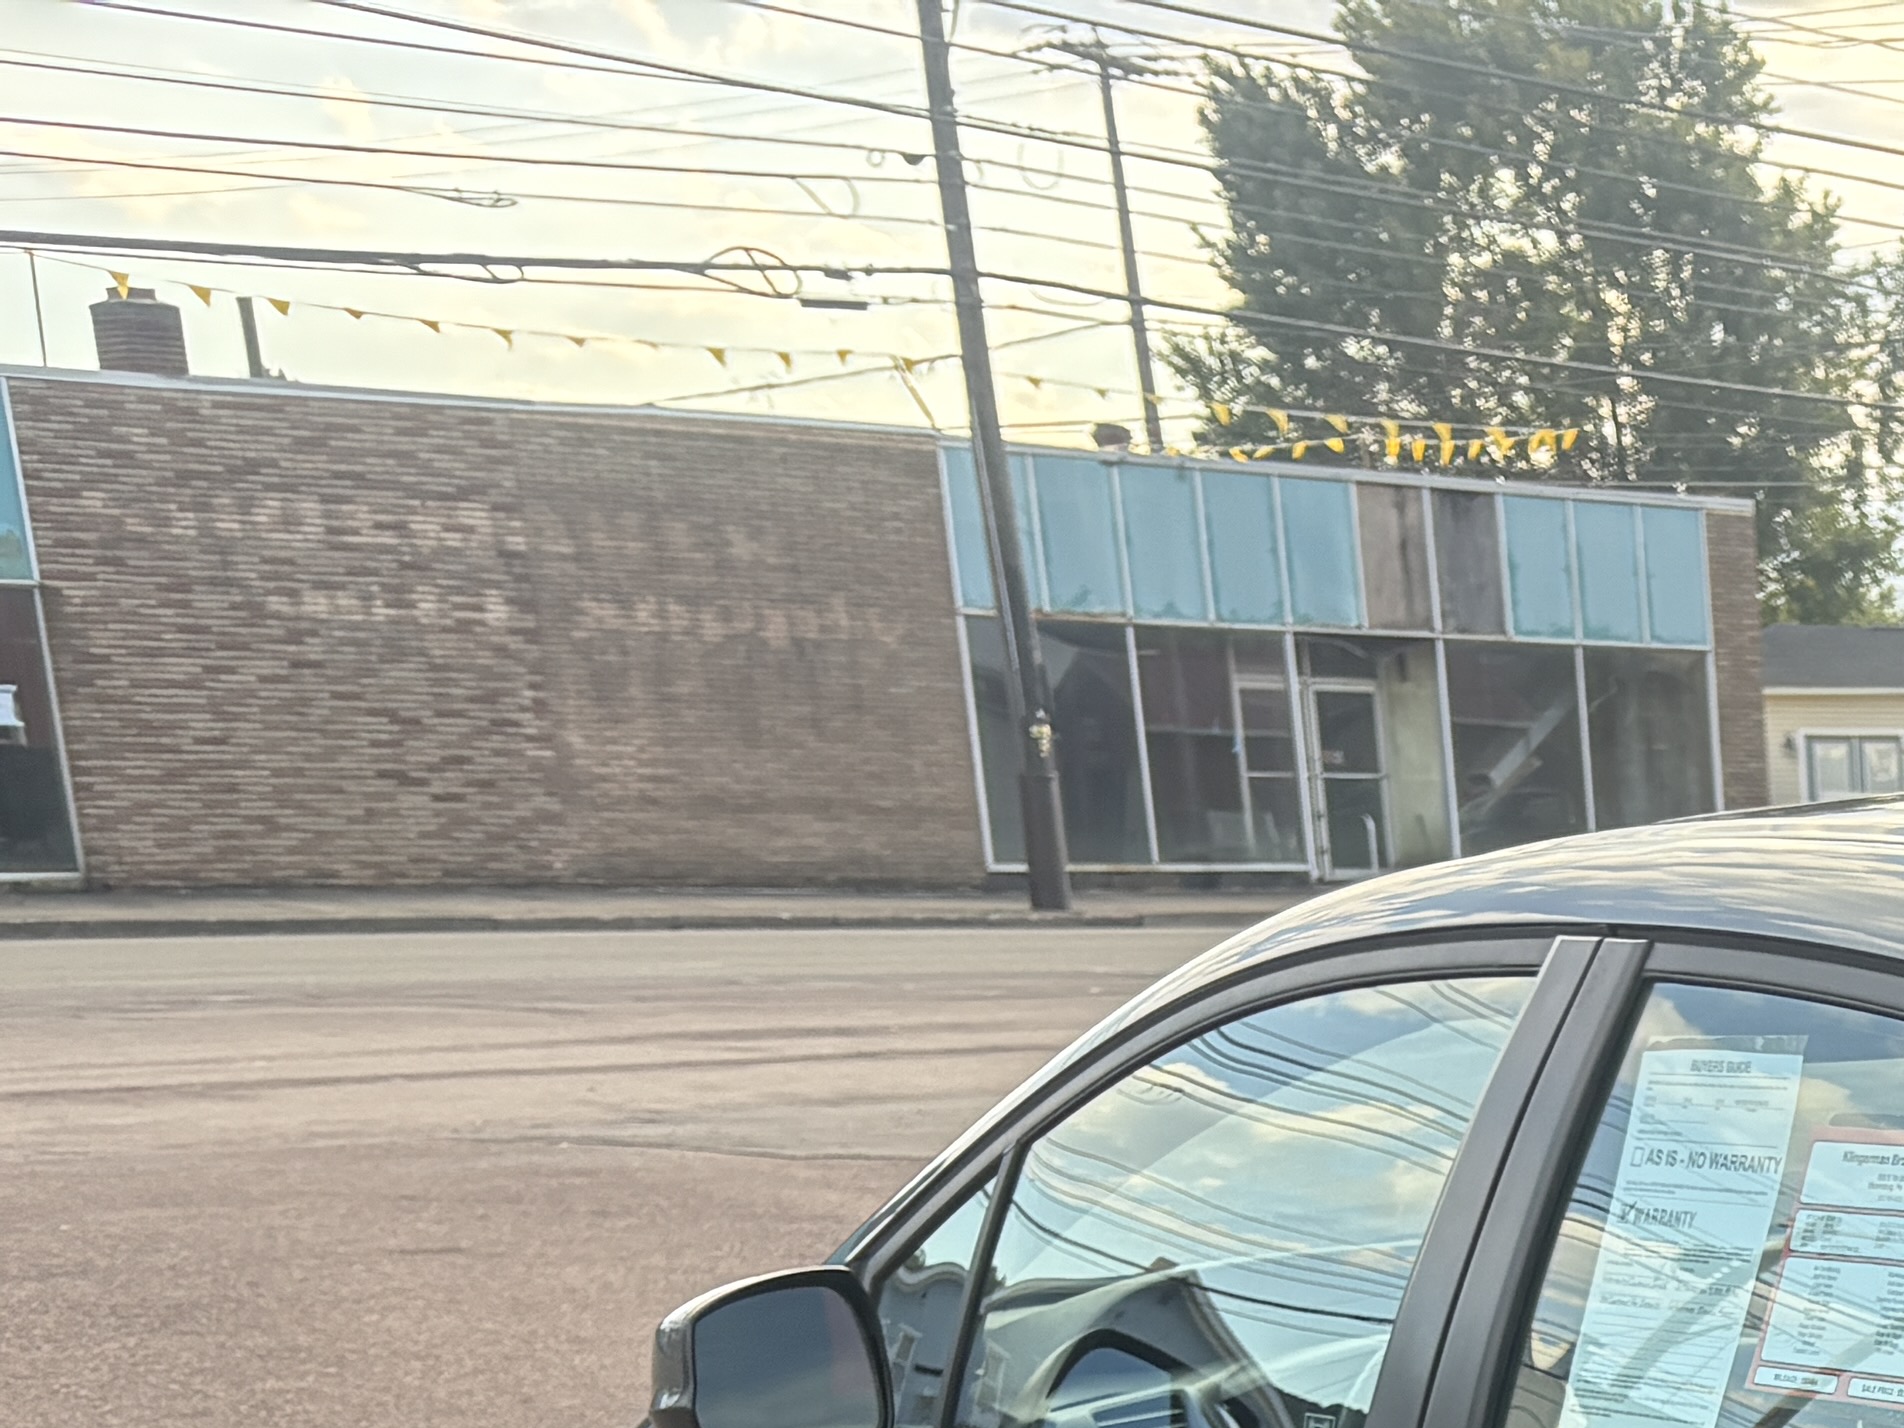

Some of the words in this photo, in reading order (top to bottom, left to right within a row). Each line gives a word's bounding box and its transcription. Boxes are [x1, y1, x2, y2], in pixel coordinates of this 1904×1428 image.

[1645, 1148, 1663, 1166] AS
[1665, 1150, 1678, 1167] IS
[1685, 1151, 1707, 1170] NO
[1708, 1151, 1783, 1175] WARRANTY
[1634, 1206, 1698, 1230] WARRANTY
